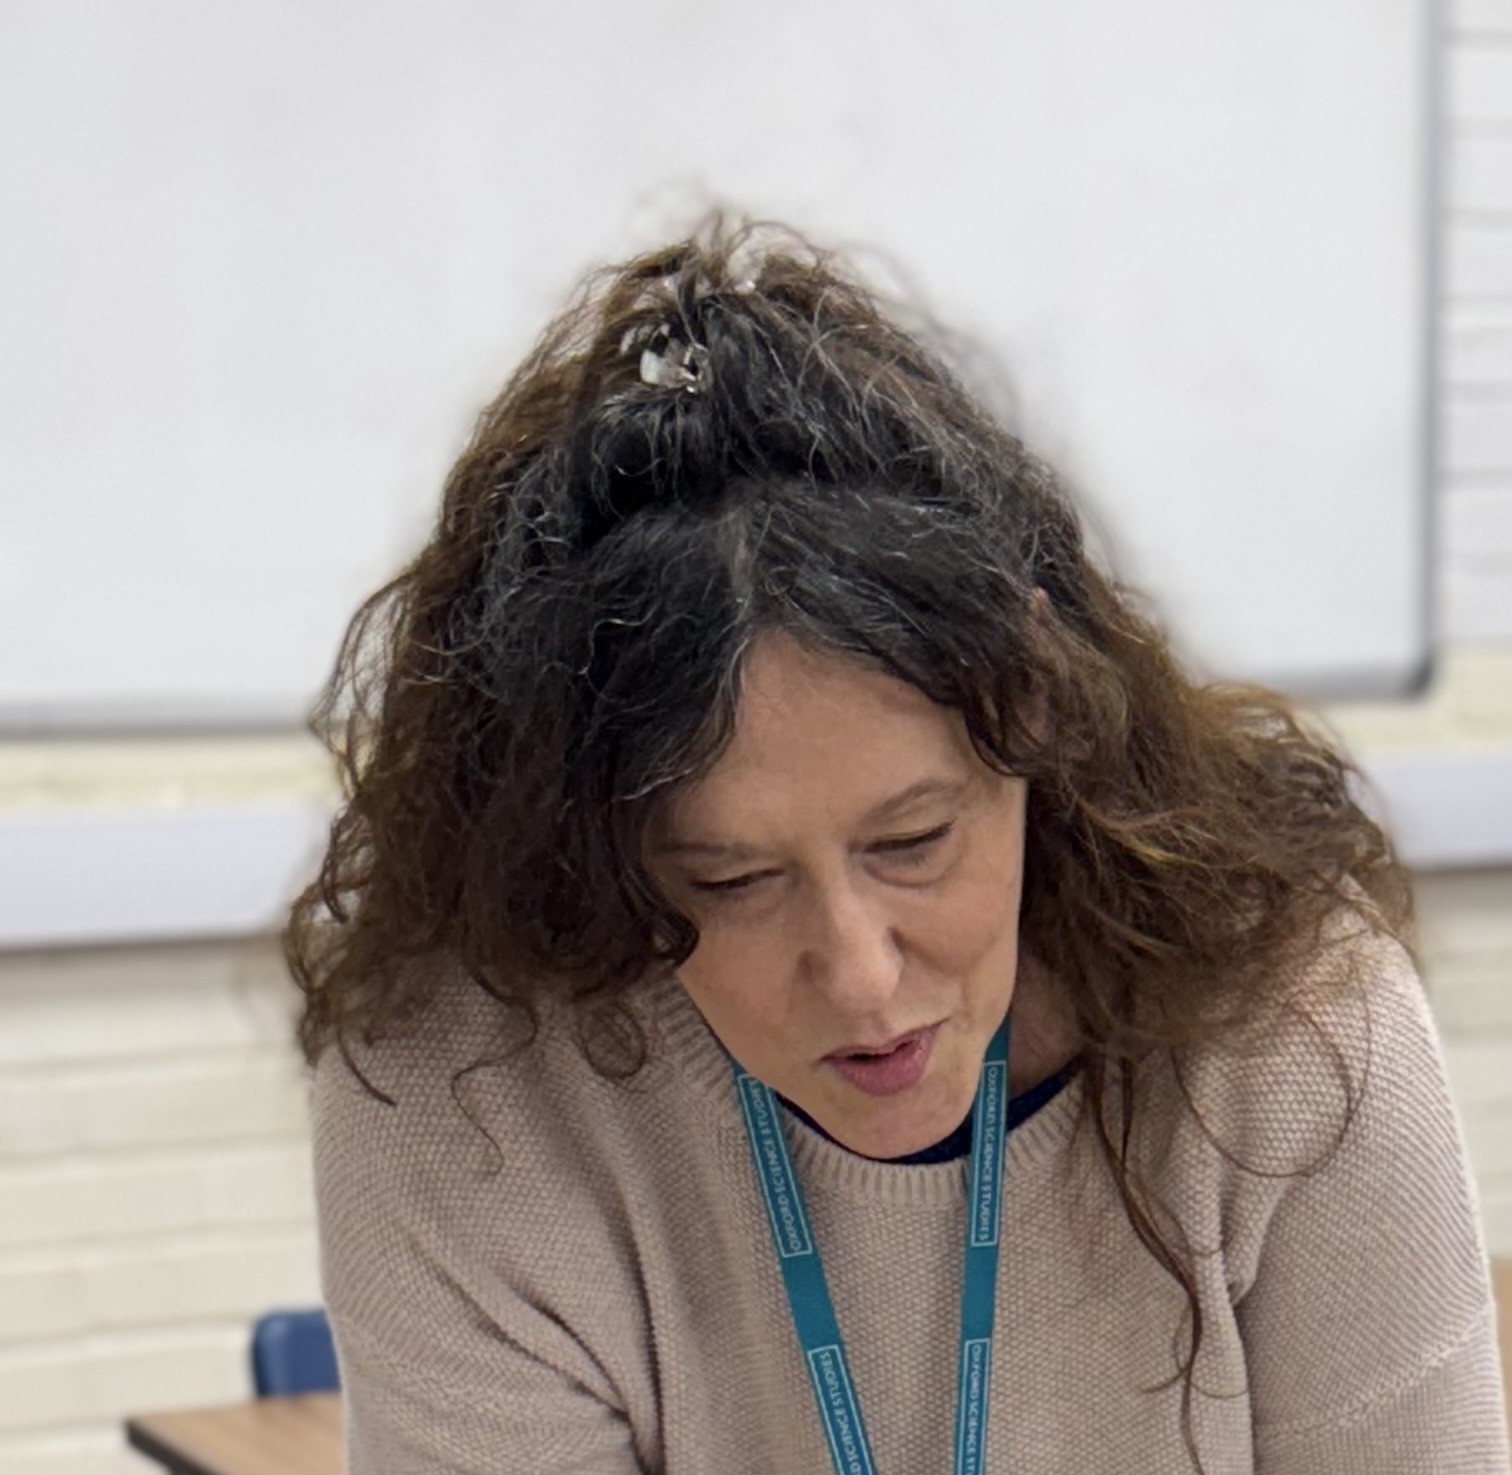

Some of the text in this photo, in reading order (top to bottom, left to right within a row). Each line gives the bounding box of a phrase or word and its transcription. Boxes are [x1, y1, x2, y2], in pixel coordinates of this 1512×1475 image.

[764, 1138, 785, 1194] SCIENCE
[980, 1067, 998, 1241] OXFORD SCIENCE STUDIES
[778, 1194, 801, 1252] OXFORD
[820, 1352, 843, 1408] STUDIES
[970, 1345, 982, 1399] OXFORD
[836, 1408, 857, 1462] SCIENCE
[966, 1401, 979, 1454] SCIENCE
